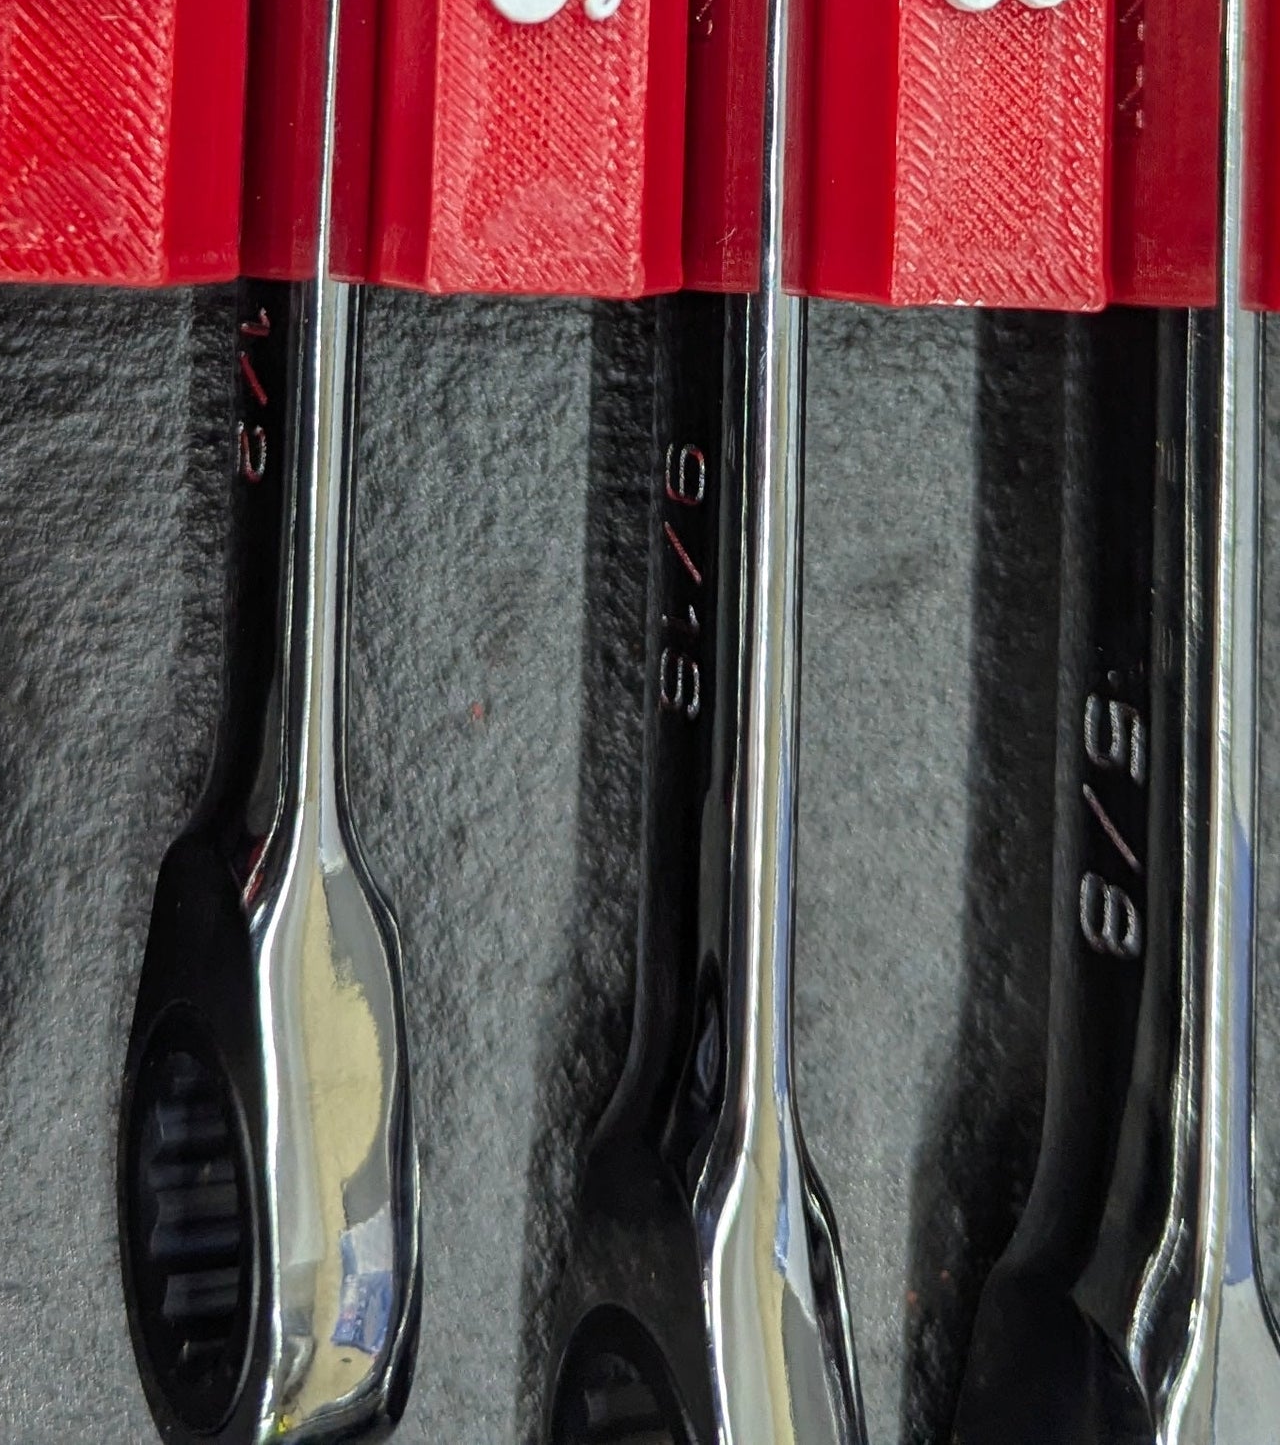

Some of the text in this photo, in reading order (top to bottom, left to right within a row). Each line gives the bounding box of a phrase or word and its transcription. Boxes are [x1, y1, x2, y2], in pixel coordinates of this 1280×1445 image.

[236, 305, 270, 484] 1/2
[657, 441, 708, 722] 9/16
[1078, 690, 1147, 957] 5/8
